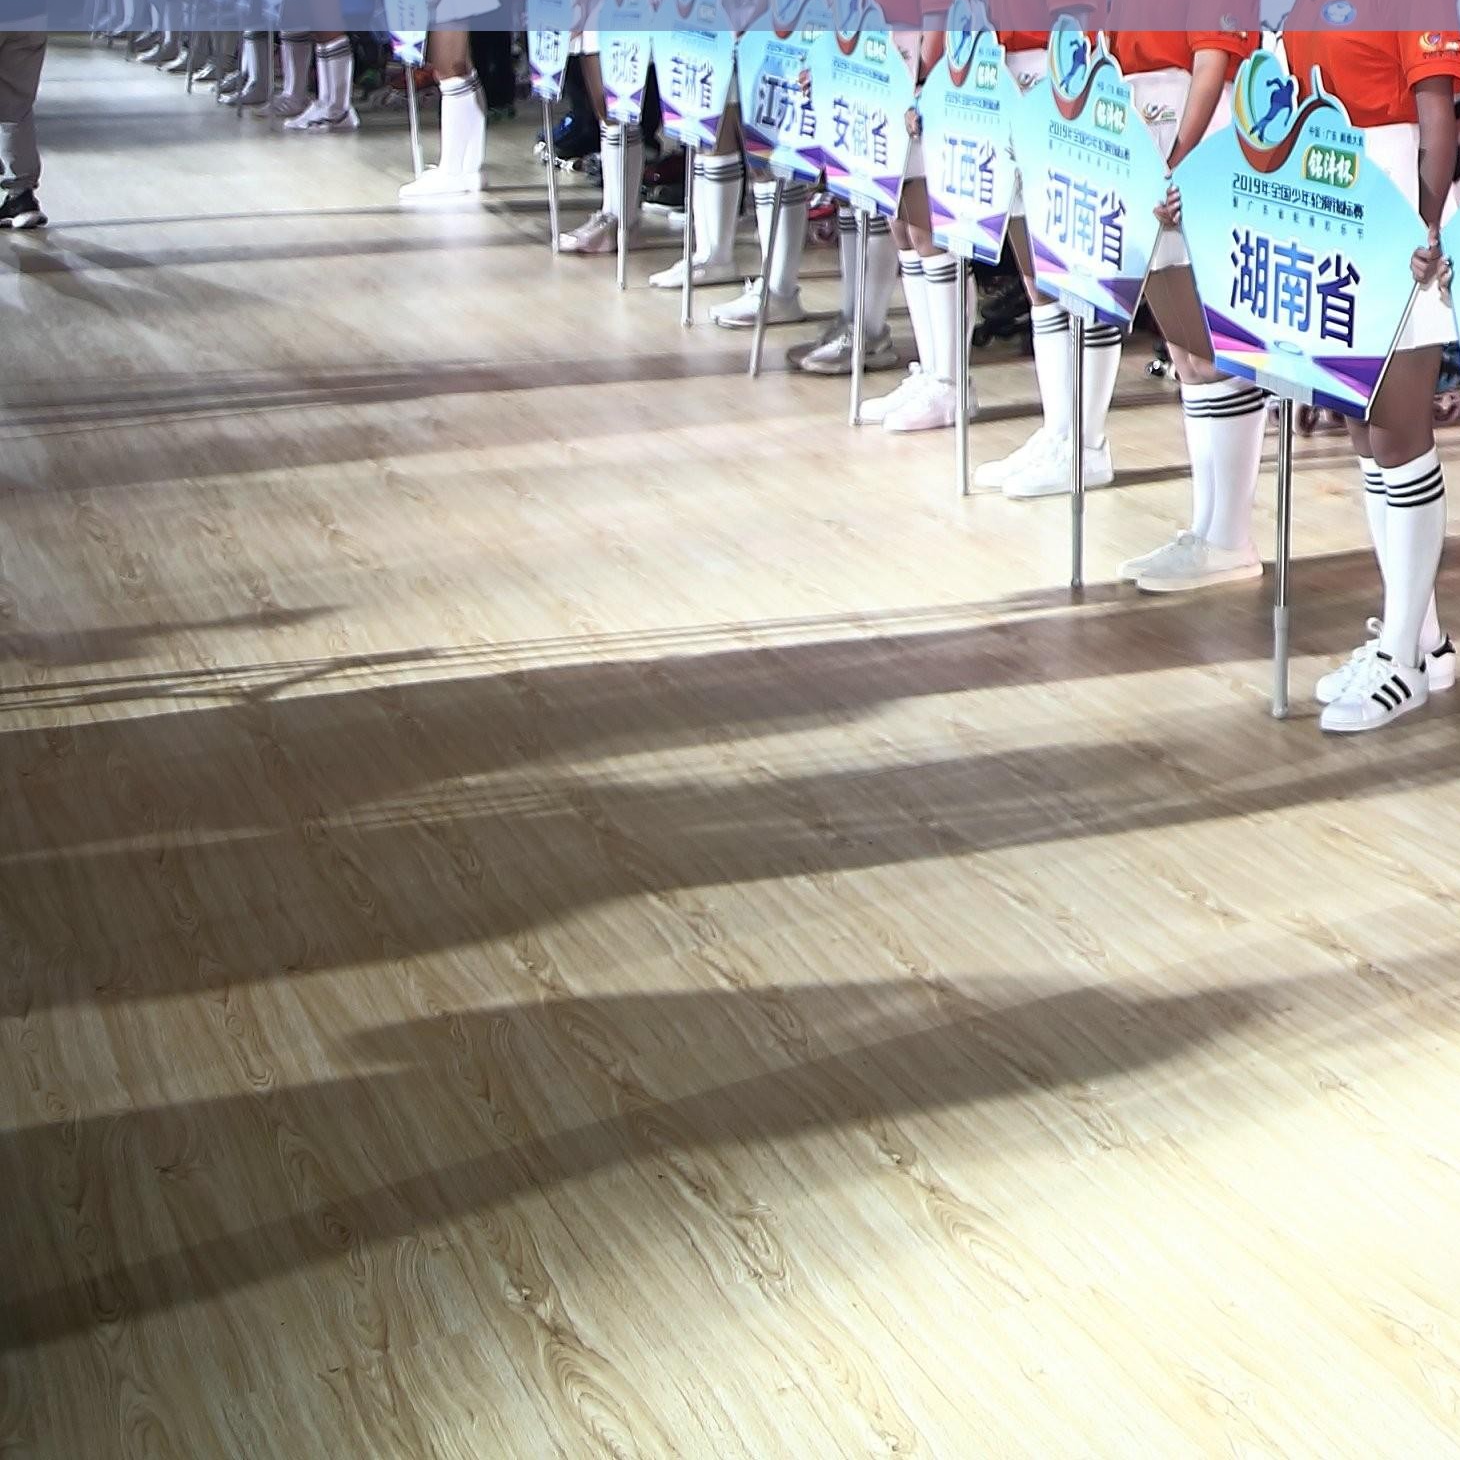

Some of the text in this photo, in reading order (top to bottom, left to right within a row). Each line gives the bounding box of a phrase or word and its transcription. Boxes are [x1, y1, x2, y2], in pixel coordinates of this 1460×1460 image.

[756, 74, 816, 140] 江苏省
[943, 133, 996, 206] 江西省
[1046, 167, 1127, 271] 河南省
[1230, 227, 1361, 349] 湖南省
